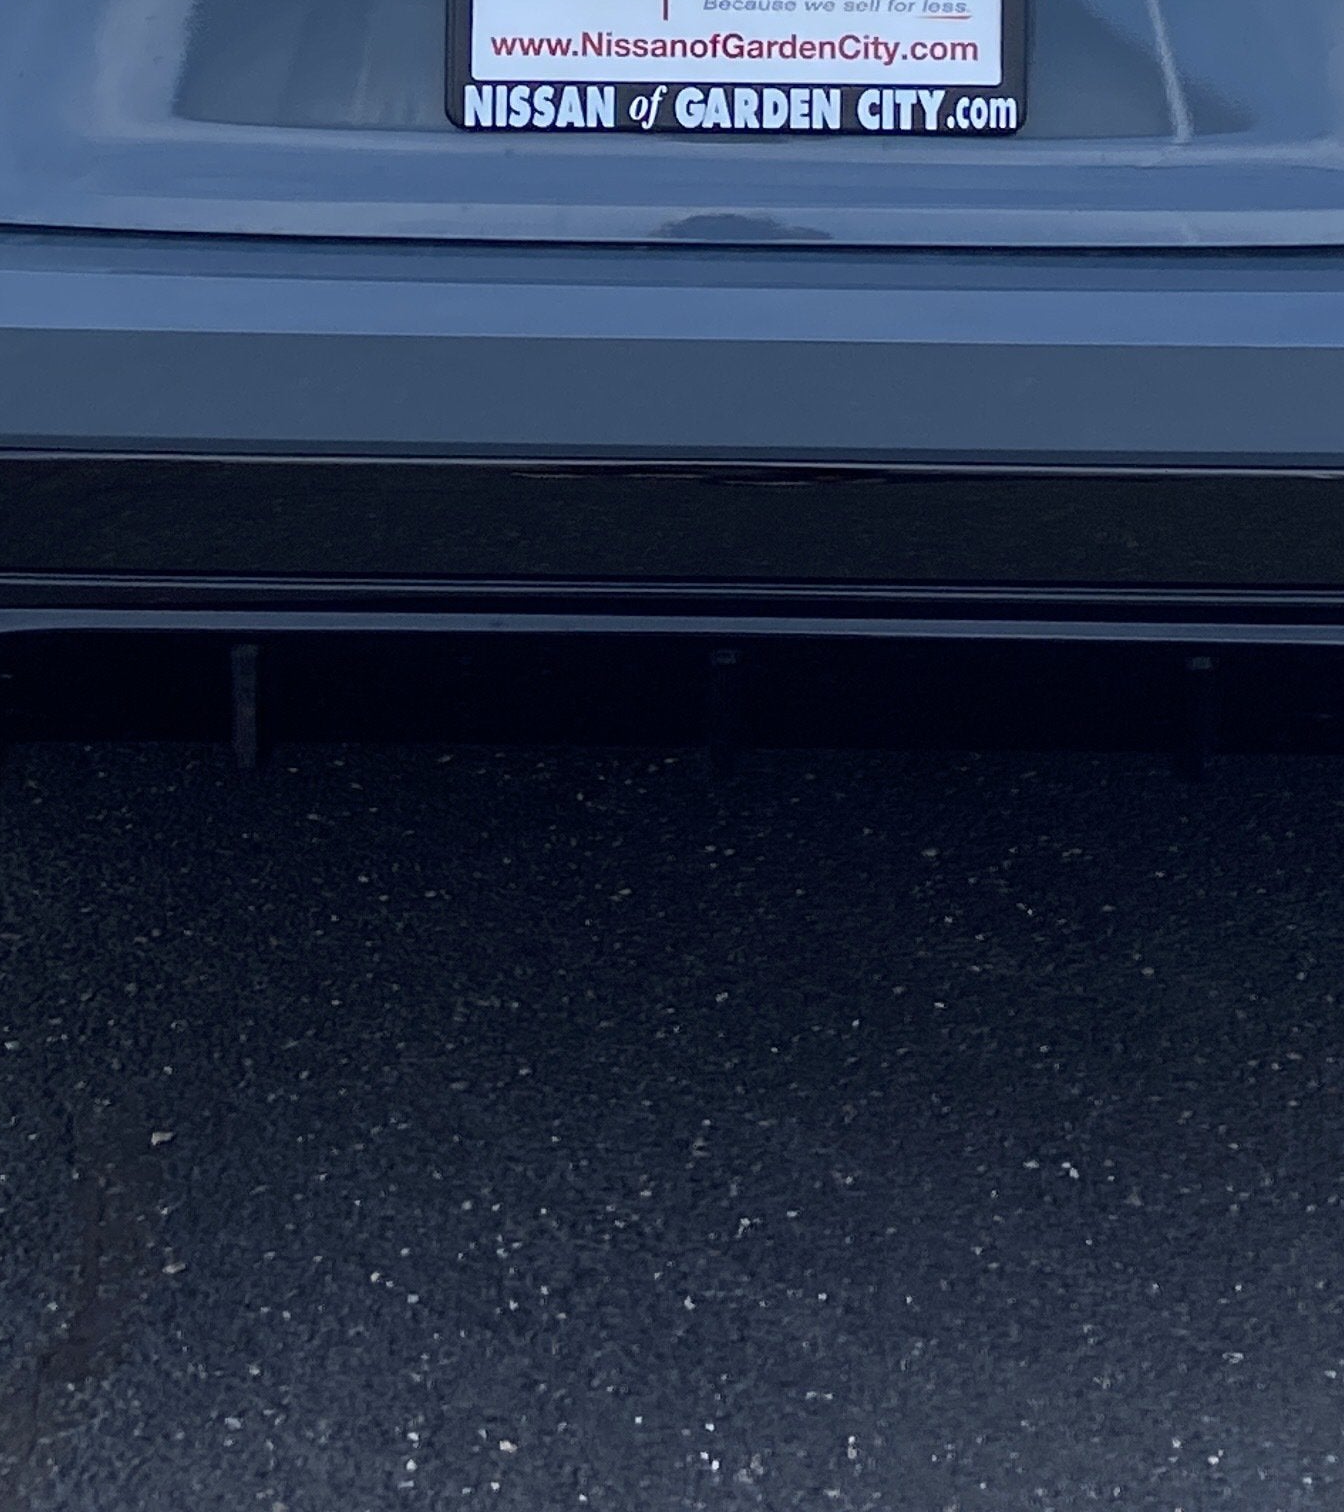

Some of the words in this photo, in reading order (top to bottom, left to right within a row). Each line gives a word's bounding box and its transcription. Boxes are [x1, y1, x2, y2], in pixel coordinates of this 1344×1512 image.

[805, 0, 835, 12] we
[491, 32, 979, 65] www.NissanofGardenCity.com
[464, 85, 616, 128] NISSAN
[629, 85, 668, 129] of
[674, 86, 842, 129] GARDEN
[856, 88, 1018, 130] CITY.com
